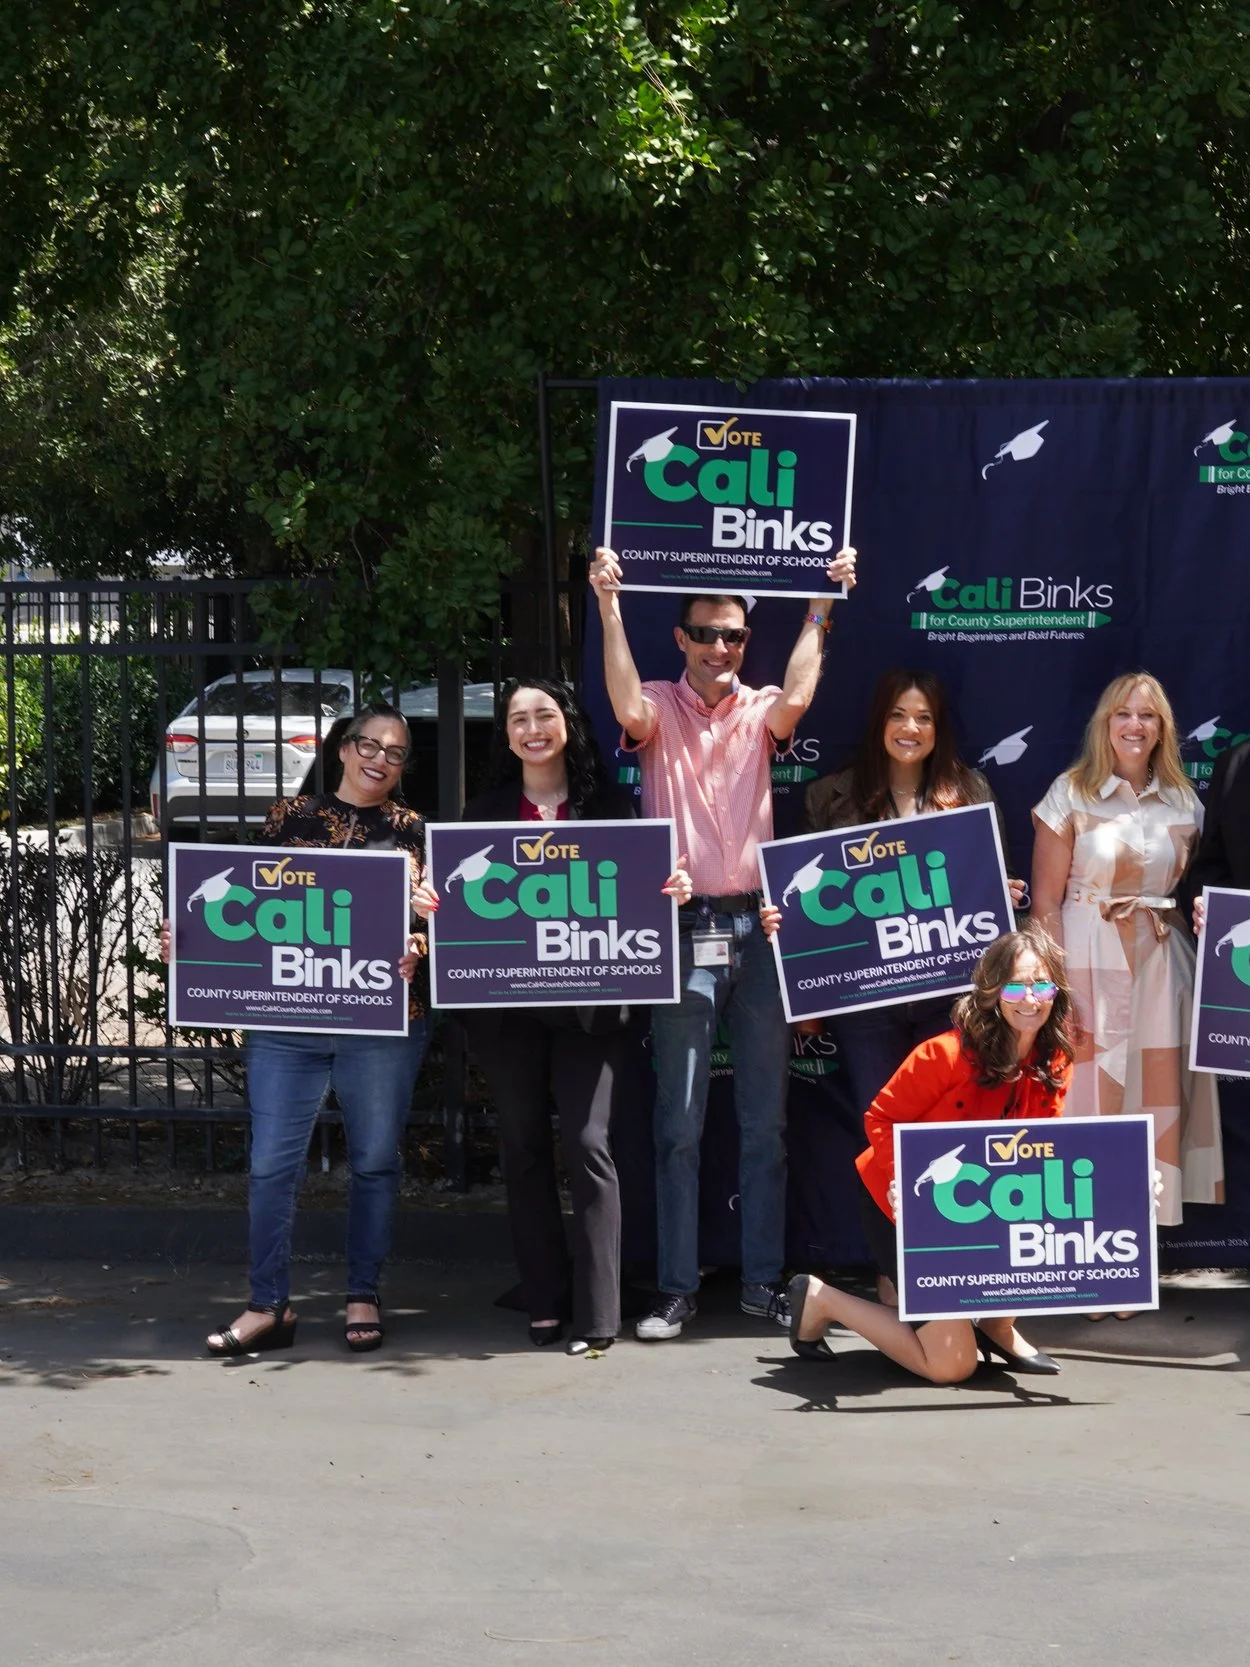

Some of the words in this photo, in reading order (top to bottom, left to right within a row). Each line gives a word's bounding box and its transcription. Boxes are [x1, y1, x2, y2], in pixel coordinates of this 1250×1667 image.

[644, 445, 797, 507] Cali
[1217, 484, 1245, 496] Bright
[1218, 468, 1232, 480] for
[712, 507, 833, 552] Binks
[622, 550, 669, 561] COUNTY
[670, 552, 765, 565] SUPERINTENDENT
[766, 555, 781, 566] OF
[932, 577, 1013, 610] Cali
[1020, 576, 1114, 609] Binks
[928, 632, 956, 644] Bright
[958, 631, 1007, 643] Beginnings
[1008, 630, 1026, 641] and
[1028, 630, 1049, 641] Bold
[1050, 630, 1085, 640] Futures
[930, 616, 946, 627] for
[948, 615, 990, 631] County
[993, 614, 1086, 629] Superintendent
[463, 860, 618, 919] Cali
[800, 851, 952, 926] Cali
[204, 885, 352, 946] Cali
[875, 907, 1000, 959] Binks
[536, 920, 661, 961] Binks
[272, 946, 392, 990] Binks
[448, 968, 494, 979] COUNTY
[496, 966, 592, 978] SUPERINTENDENT
[593, 966, 609, 976] OF
[611, 965, 662, 976] SCHOOLS
[798, 974, 842, 990] COUNTY
[843, 957, 935, 982] SUPERINTENDENT
[937, 954, 952, 965] OF
[186, 988, 231, 999] COUNTY
[232, 990, 324, 1003] SUPERINTENDENT
[326, 994, 341, 1004] OF
[343, 994, 392, 1006] SCHOOLS
[933, 1158, 1094, 1223] Cali
[1010, 1221, 1139, 1267] Binks
[1166, 1240, 1226, 1249] Superintendent
[1228, 1238, 1248, 1247] 2026
[917, 1276, 966, 1287] COUNTY
[967, 1271, 1067, 1285] SUPERINTENDENT
[1069, 1270, 1085, 1280] OF
[1087, 1268, 1139, 1280] SCHOOLS
